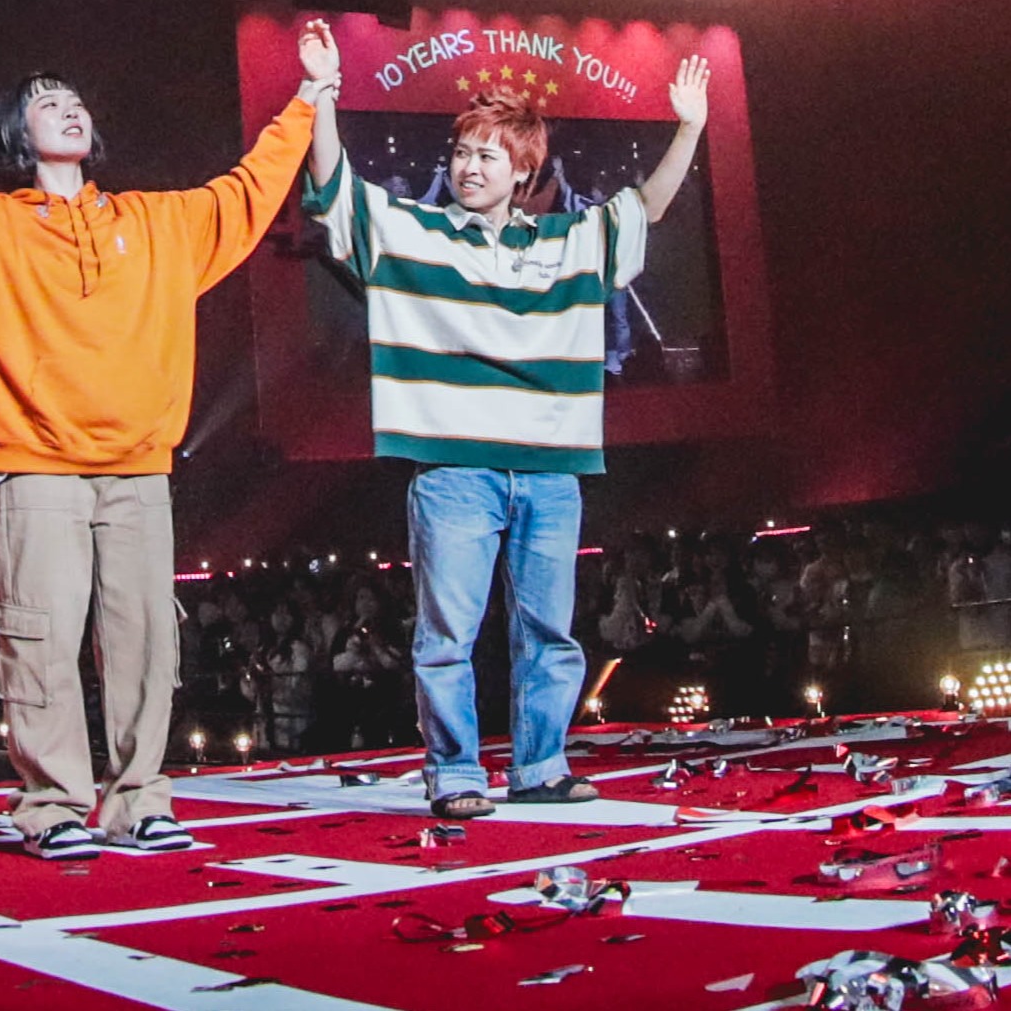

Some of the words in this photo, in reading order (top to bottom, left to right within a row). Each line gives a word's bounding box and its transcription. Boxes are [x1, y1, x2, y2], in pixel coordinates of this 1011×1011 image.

[375, 62, 404, 91] 10
[396, 29, 475, 74] YEARS
[483, 30, 564, 64] THANK
[573, 47, 636, 104] YOU!!!
